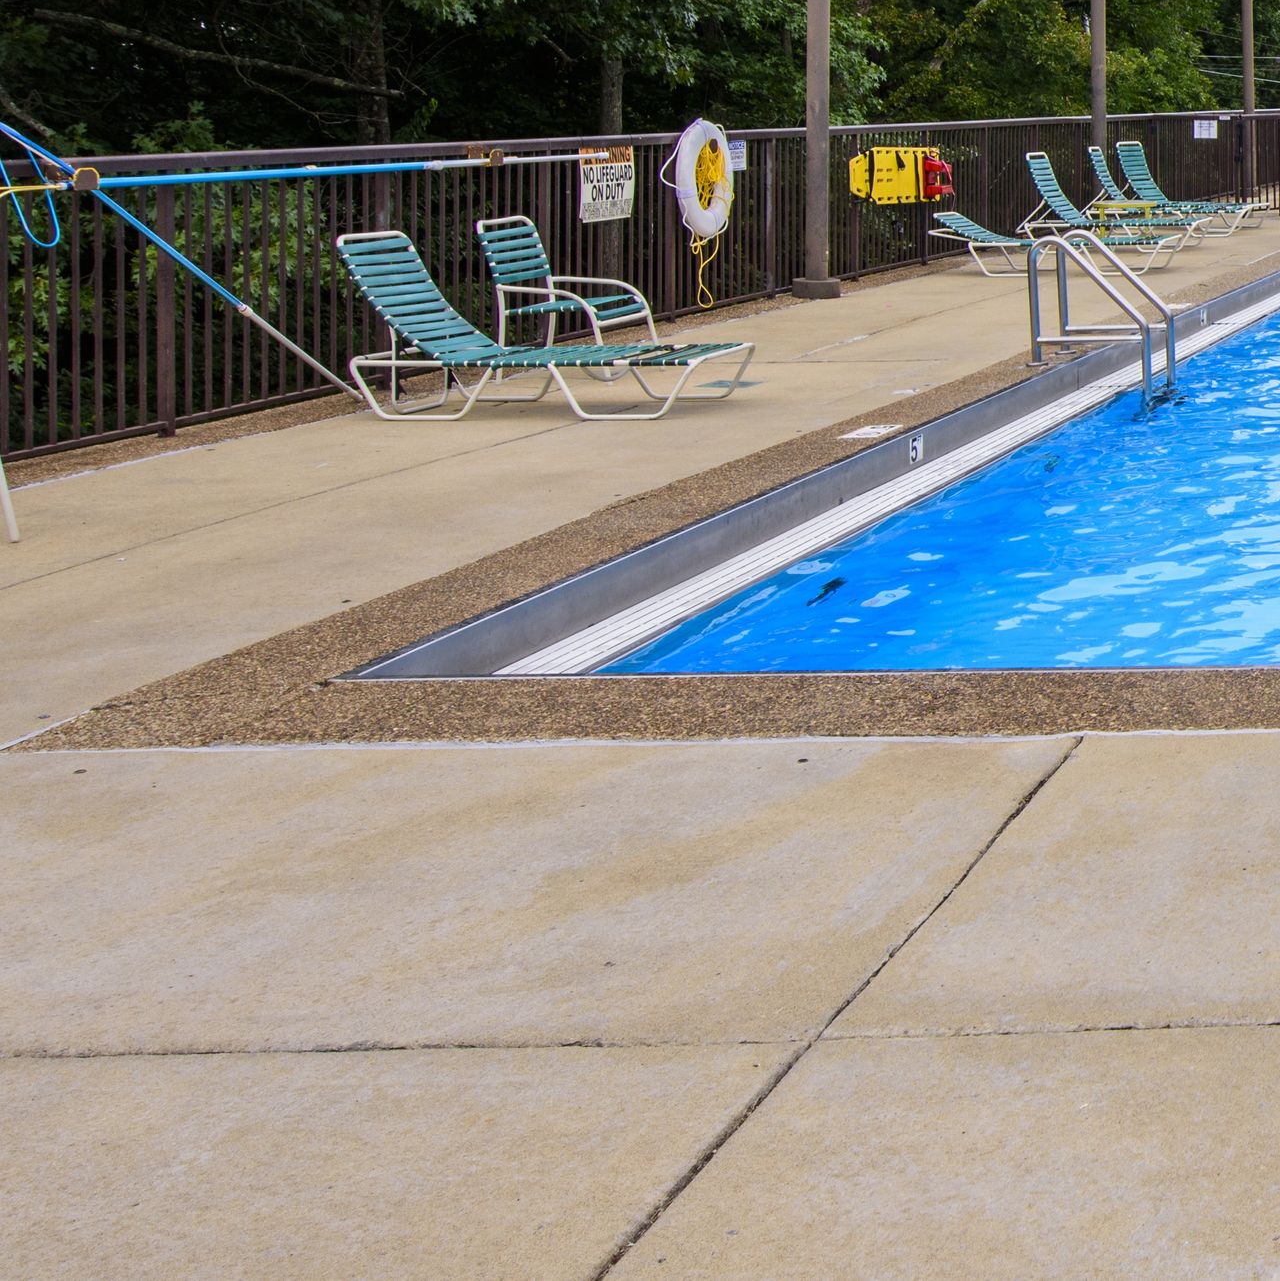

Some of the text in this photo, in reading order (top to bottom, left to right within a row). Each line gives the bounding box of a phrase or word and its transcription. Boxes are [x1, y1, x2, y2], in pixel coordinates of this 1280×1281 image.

[583, 164, 633, 184] NO LIFEGUARD
[591, 182, 625, 202] ON DUTY
[911, 437, 918, 462] 5
